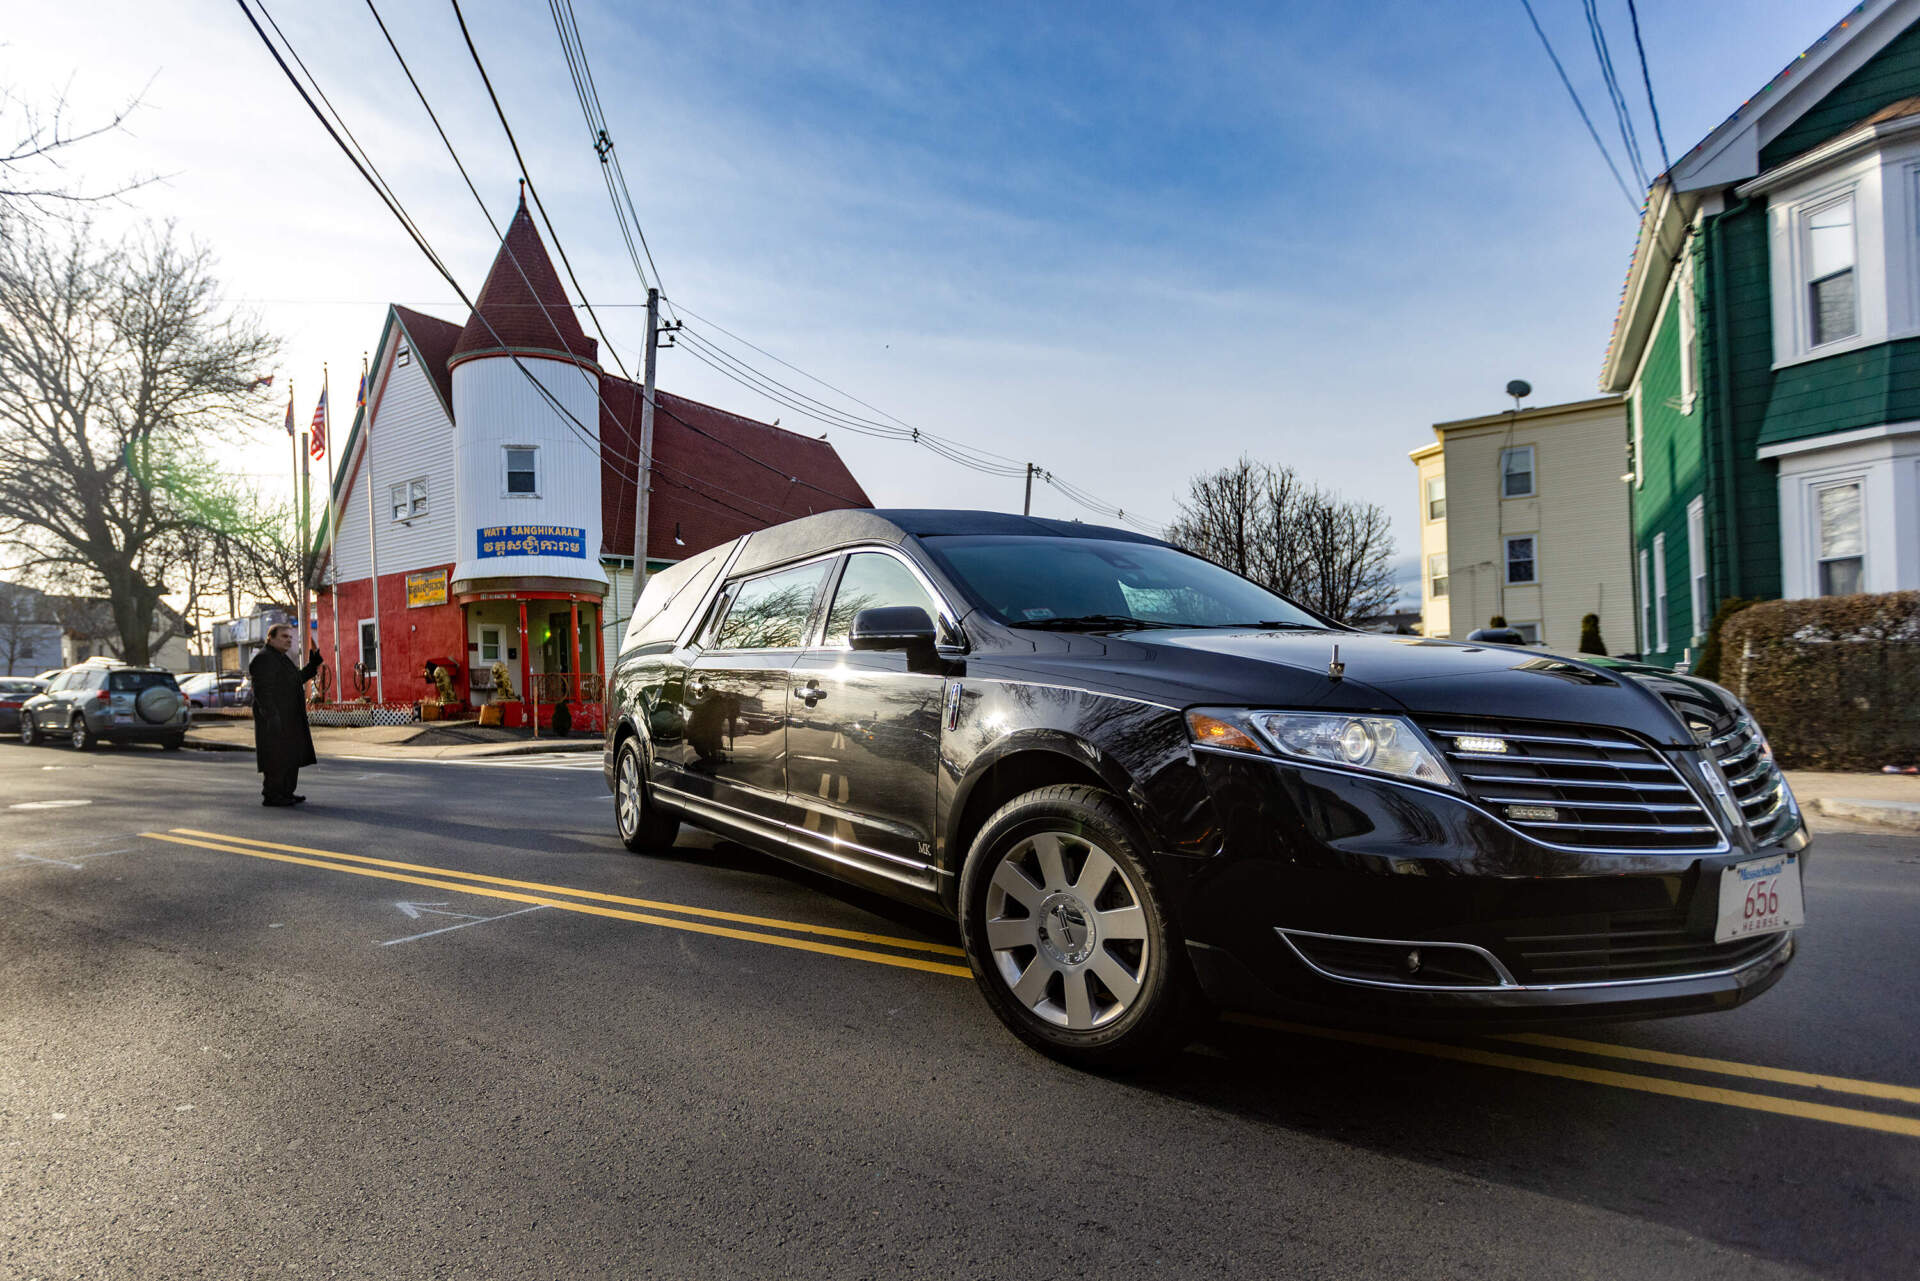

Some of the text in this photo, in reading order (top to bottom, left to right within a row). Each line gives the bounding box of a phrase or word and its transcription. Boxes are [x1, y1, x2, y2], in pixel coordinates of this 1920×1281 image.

[483, 526, 580, 537] WATT SANGHIKARAM
[1744, 879, 1779, 919] 656
[1743, 916, 1779, 931] HEARSE
